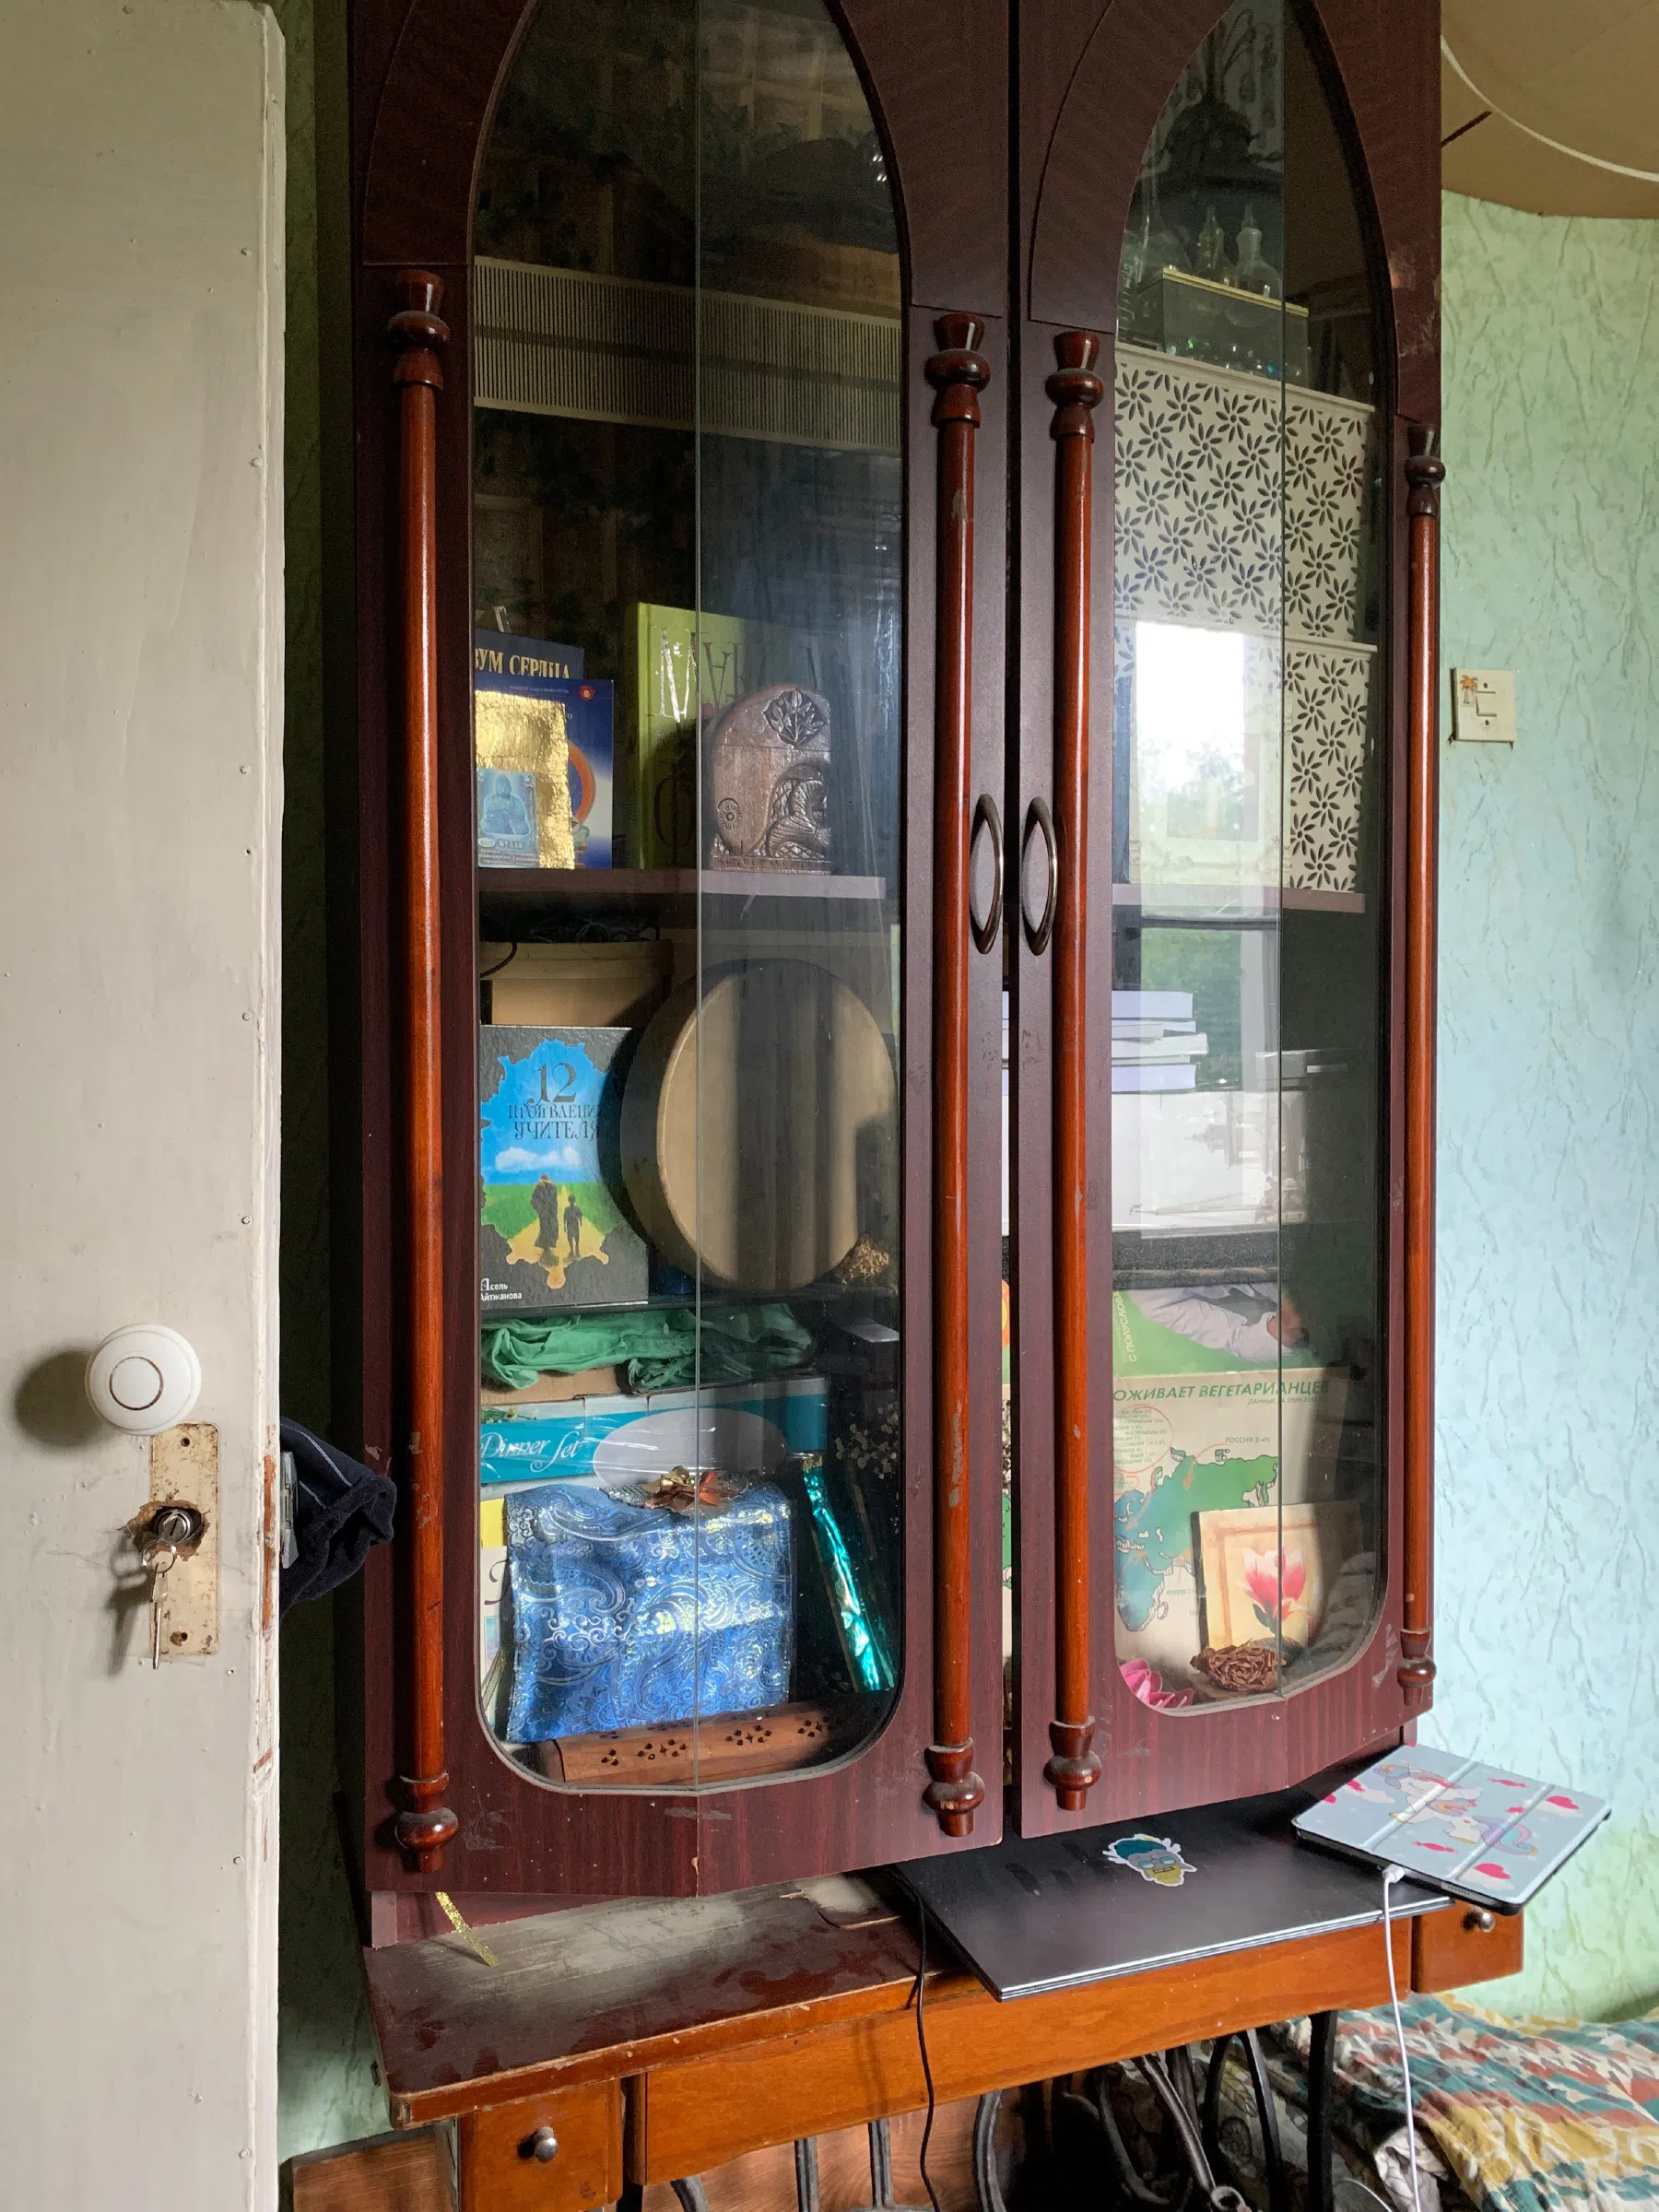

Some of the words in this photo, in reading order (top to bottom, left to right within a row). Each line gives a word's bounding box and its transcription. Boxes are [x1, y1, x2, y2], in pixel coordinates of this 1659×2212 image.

[527, 1062, 577, 1106] 12
[513, 1121, 600, 1142] УЧИТЕЛЯ
[481, 1277, 509, 1291] Асель
[1112, 1385, 1196, 1401] ОЖИВАЕТ
[1198, 1381, 1329, 1397] ВЕГЕТАРИАНЦЕВ
[480, 1432, 552, 1458] Dinner
[530, 1430, 589, 1473] Set
